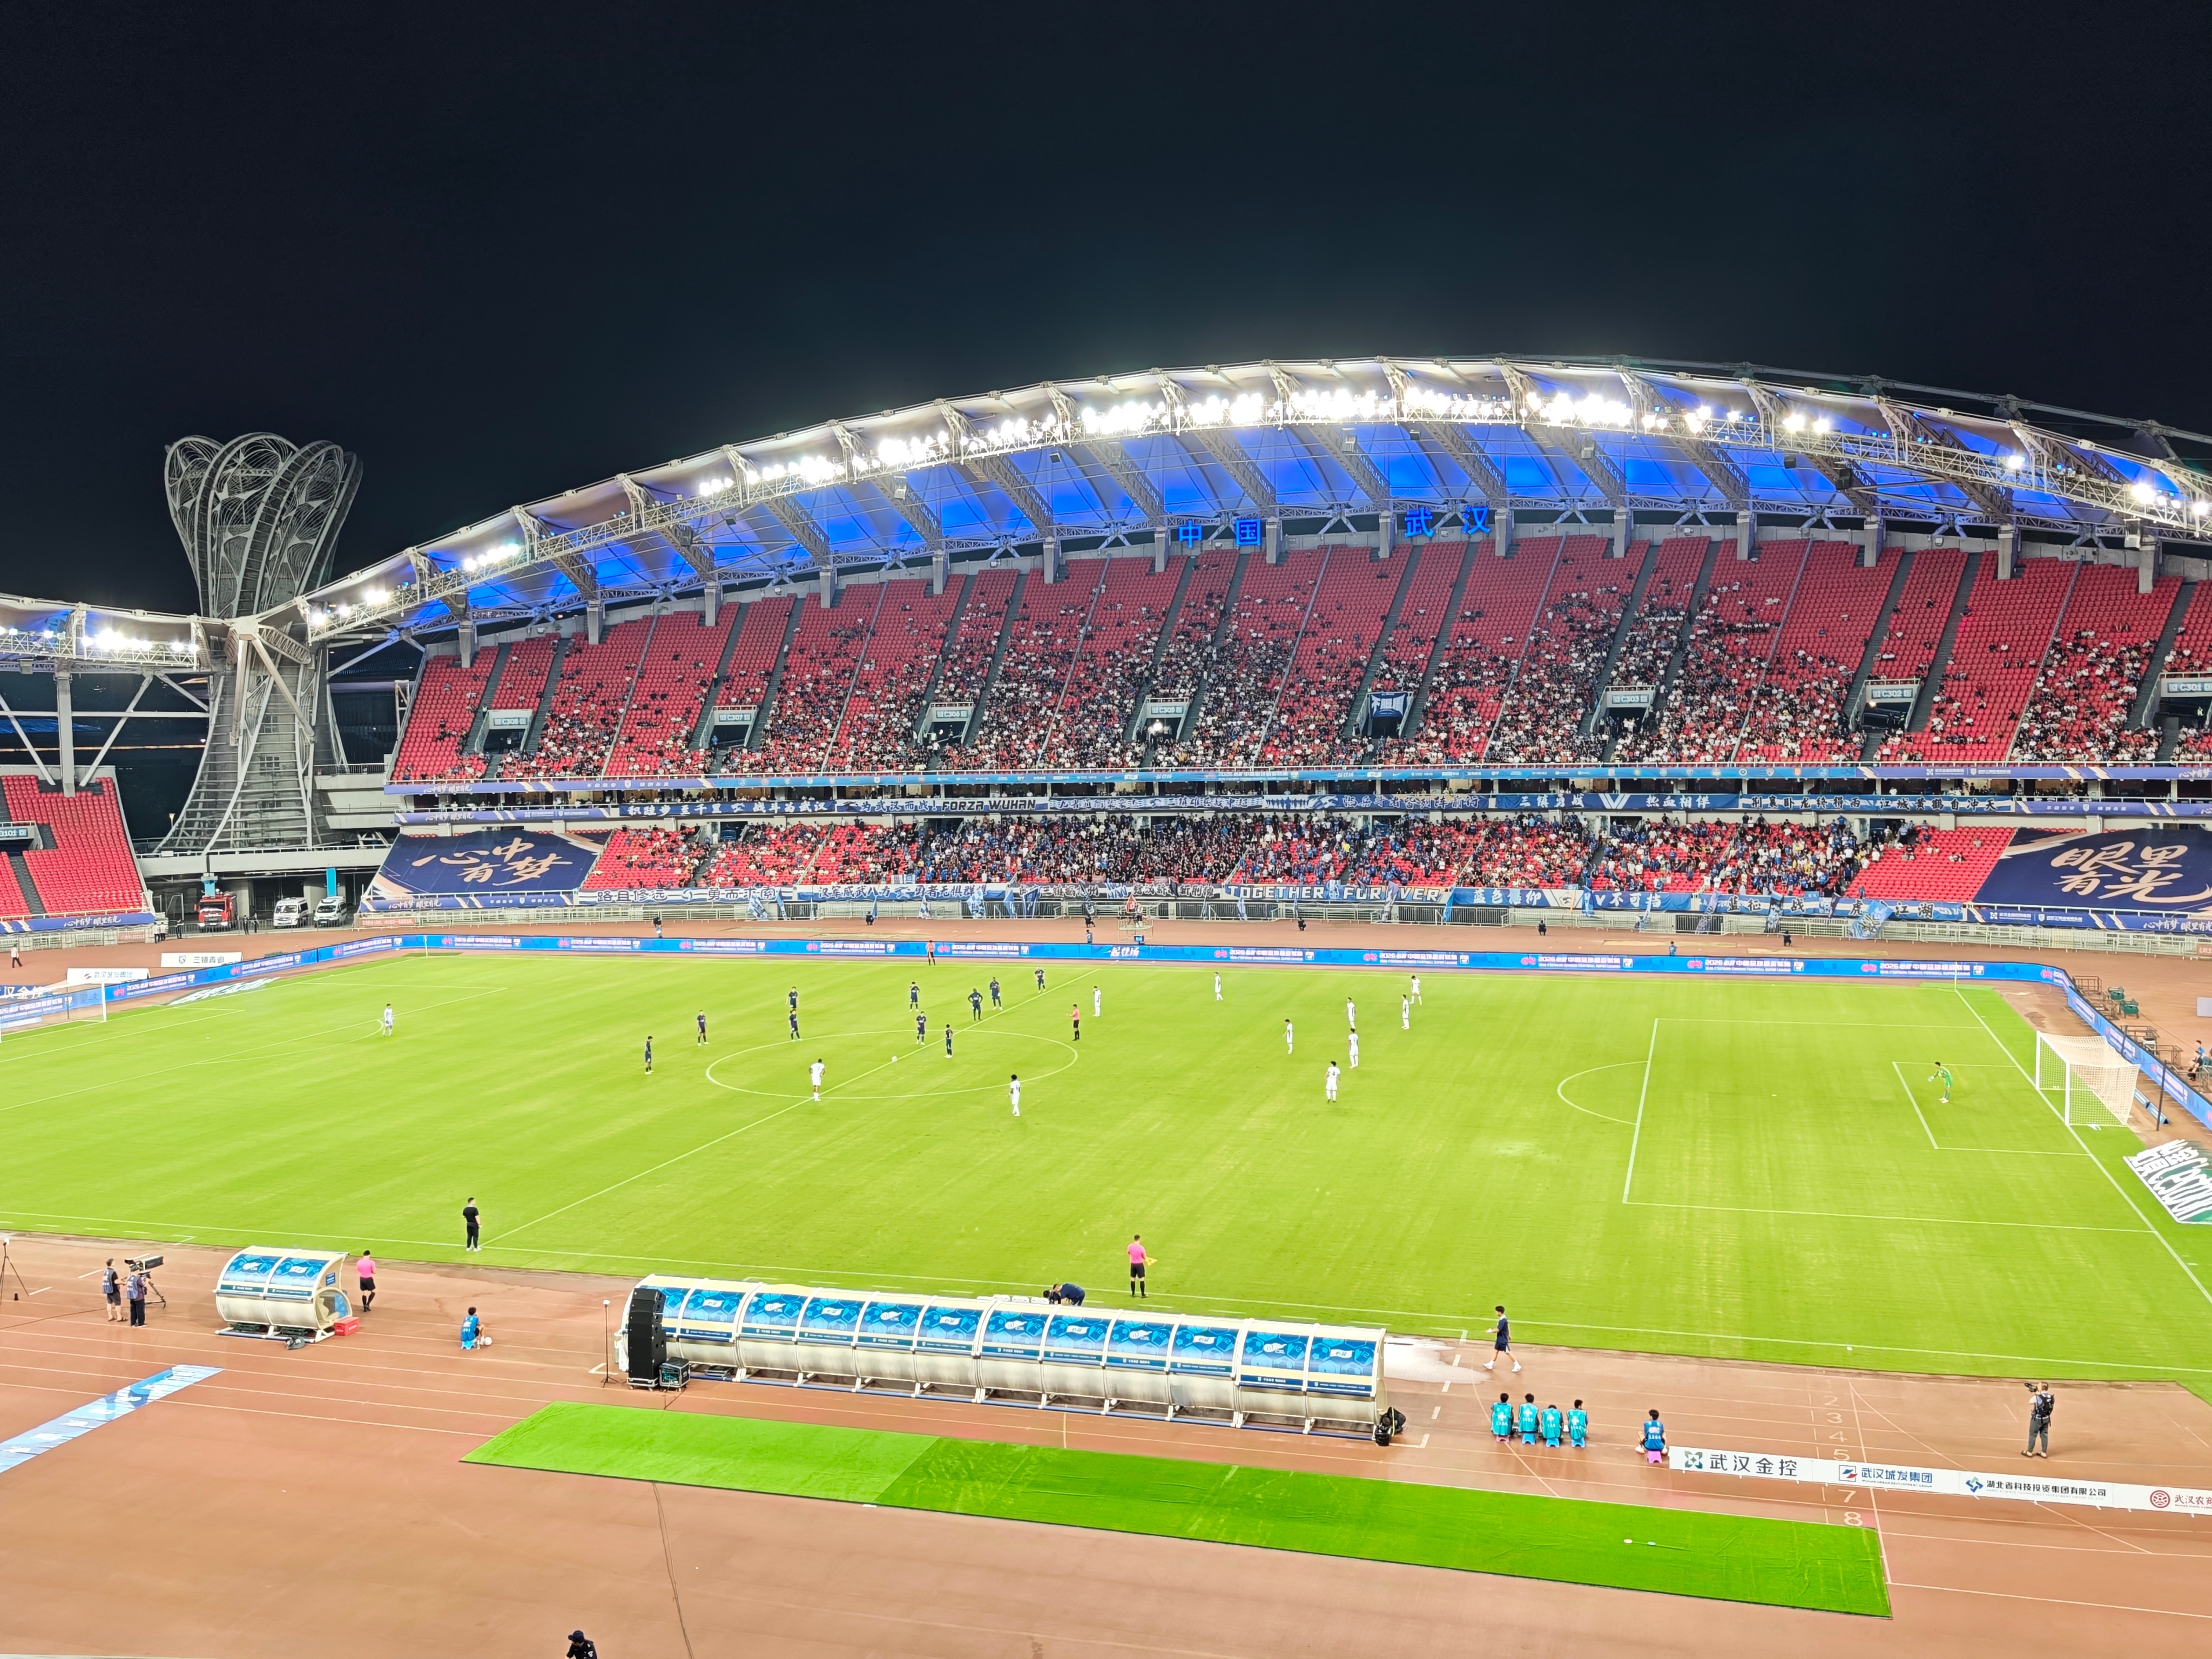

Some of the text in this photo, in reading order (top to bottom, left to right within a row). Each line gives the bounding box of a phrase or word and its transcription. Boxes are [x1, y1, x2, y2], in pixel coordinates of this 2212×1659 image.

[1179, 505, 1491, 548] 中国 武汉
[942, 800, 984, 811] FORZA
[988, 799, 1036, 810] WUHAN
[1520, 794, 1710, 808] 三镇勇战 热血相伴
[2051, 841, 2188, 874] 眼里
[457, 853, 573, 886] 有梦
[597, 886, 776, 902] 路且修远 勇而求索
[1227, 886, 1325, 900] TOGETHER
[1823, 1395, 1840, 1406] 2
[1826, 1412, 1842, 1423] 3
[1829, 1431, 1847, 1442] 4
[1833, 1448, 1850, 1461] 5
[1710, 1454, 1798, 1477] 武汉金控
[1862, 1467, 1932, 1483] 武汉城发集团
[1838, 1489, 1856, 1502] 7
[1987, 1480, 2106, 1496] 湖北省科技投资集团有限公司
[1844, 1511, 1863, 1527] 8
